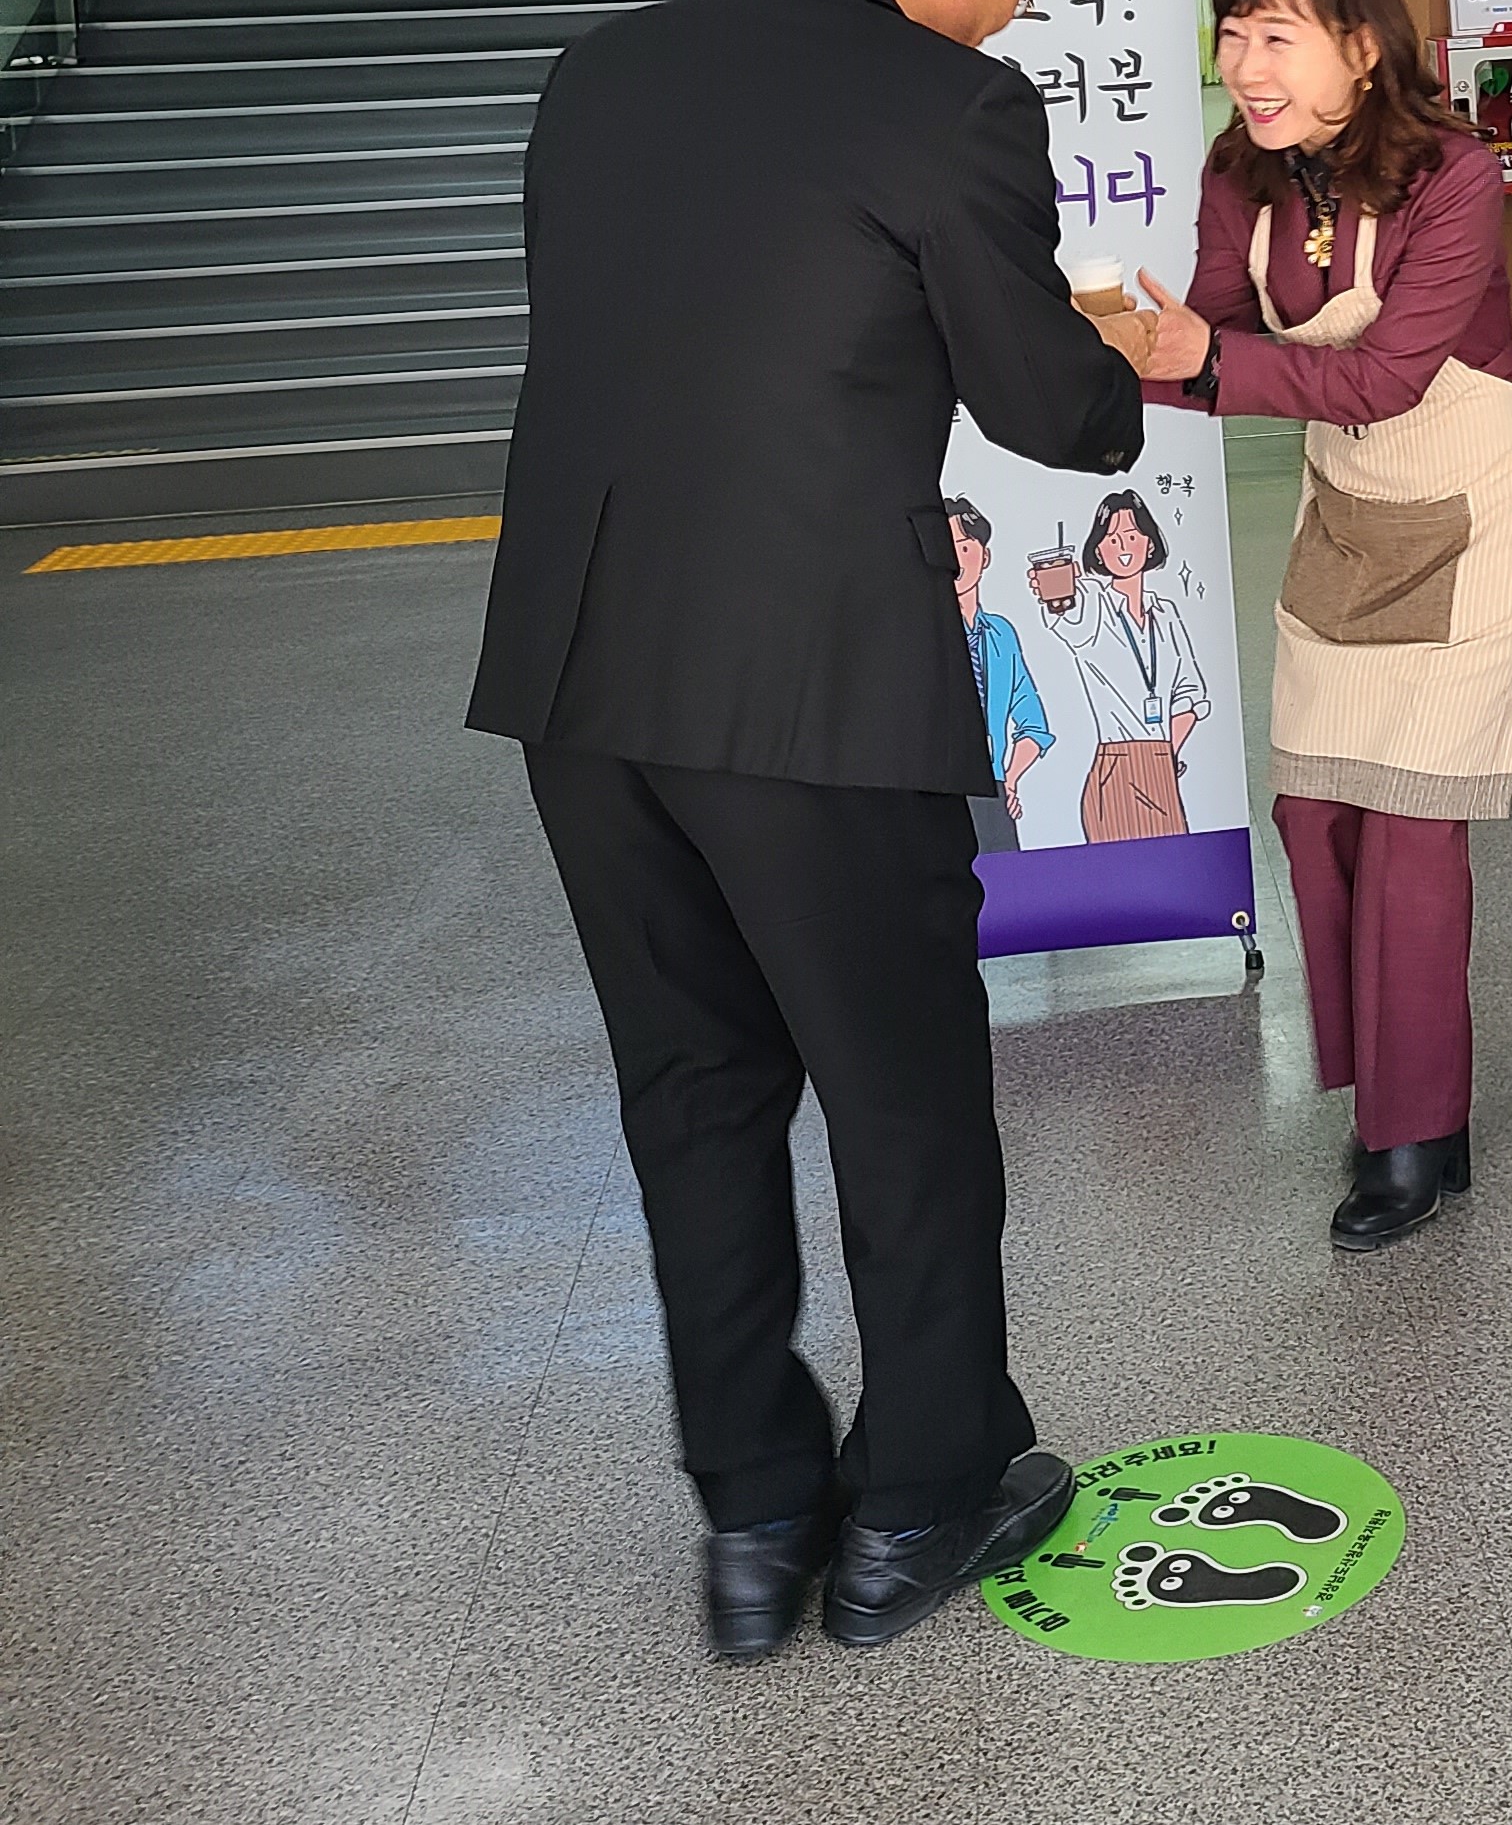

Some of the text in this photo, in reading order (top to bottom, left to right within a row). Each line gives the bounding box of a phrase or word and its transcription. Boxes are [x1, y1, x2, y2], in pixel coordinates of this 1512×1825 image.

[1155, 473, 1196, 498] 행-복
[1002, 1588, 1071, 1633] 여기에
[1074, 1460, 1124, 1493] 다려
[1121, 1439, 1217, 1467] 주세요!
[1314, 1508, 1392, 1602] 경상남도산청교육지원청
